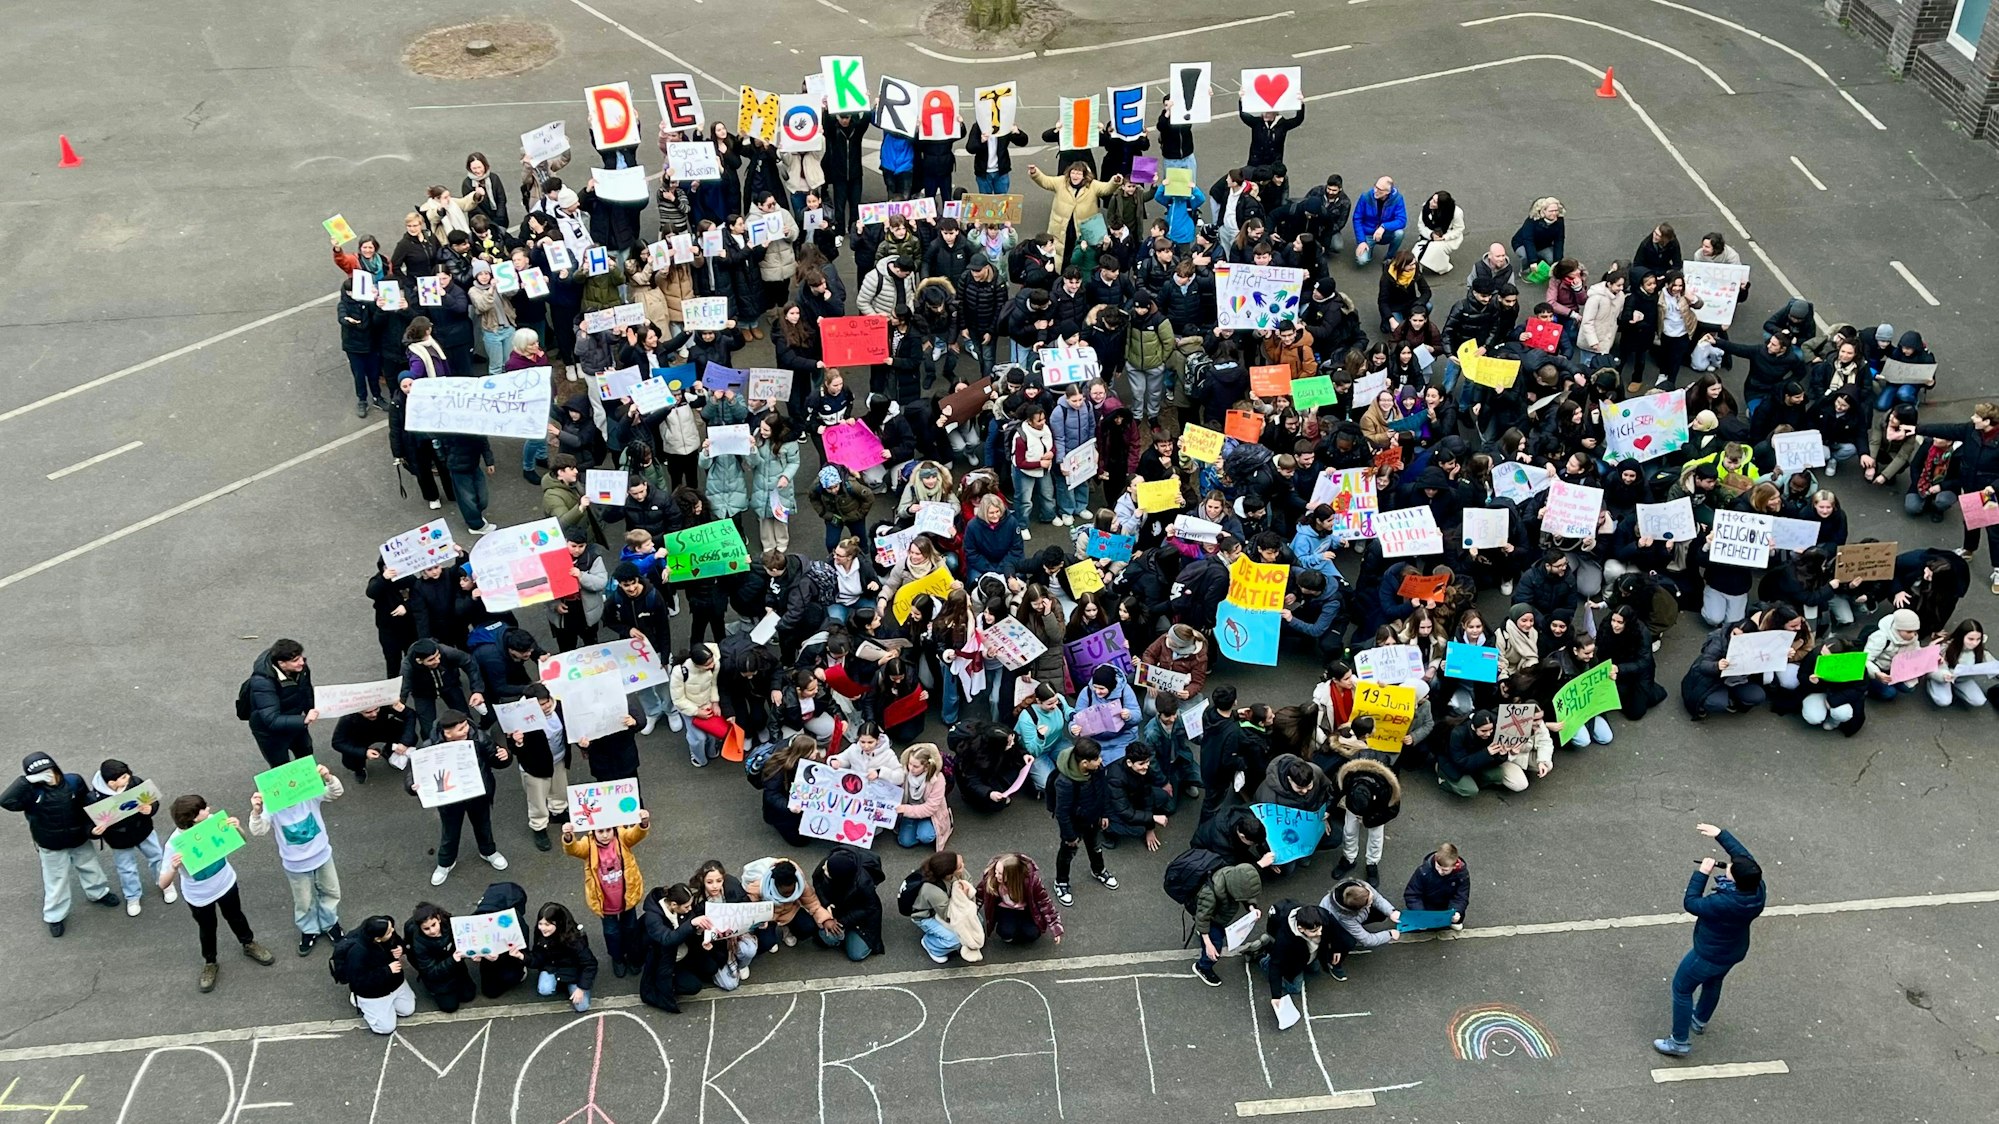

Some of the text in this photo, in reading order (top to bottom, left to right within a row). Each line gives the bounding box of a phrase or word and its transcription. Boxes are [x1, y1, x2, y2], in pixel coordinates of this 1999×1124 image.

[669, 143, 698, 160] Gegen
[1267, 269, 1295, 281] STEH
[1048, 364, 1096, 383] DEN
[1716, 523, 1770, 547] RELIGIONS
[1714, 541, 1760, 561] FREIHEIT
[893, 578, 950, 616] TOLANZ
[1229, 579, 1280, 607] KRATIE
[1068, 629, 1121, 664] FÜR
[1556, 667, 1609, 713] #ICH STEH
[1382, 713, 1410, 725] DER
[1505, 704, 1529, 719] STOP
[801, 799, 826, 811] HASS
[827, 791, 862, 815] UND
[1257, 804, 1322, 822] IELFALT
[708, 904, 772, 919] ZUSAMMEN
